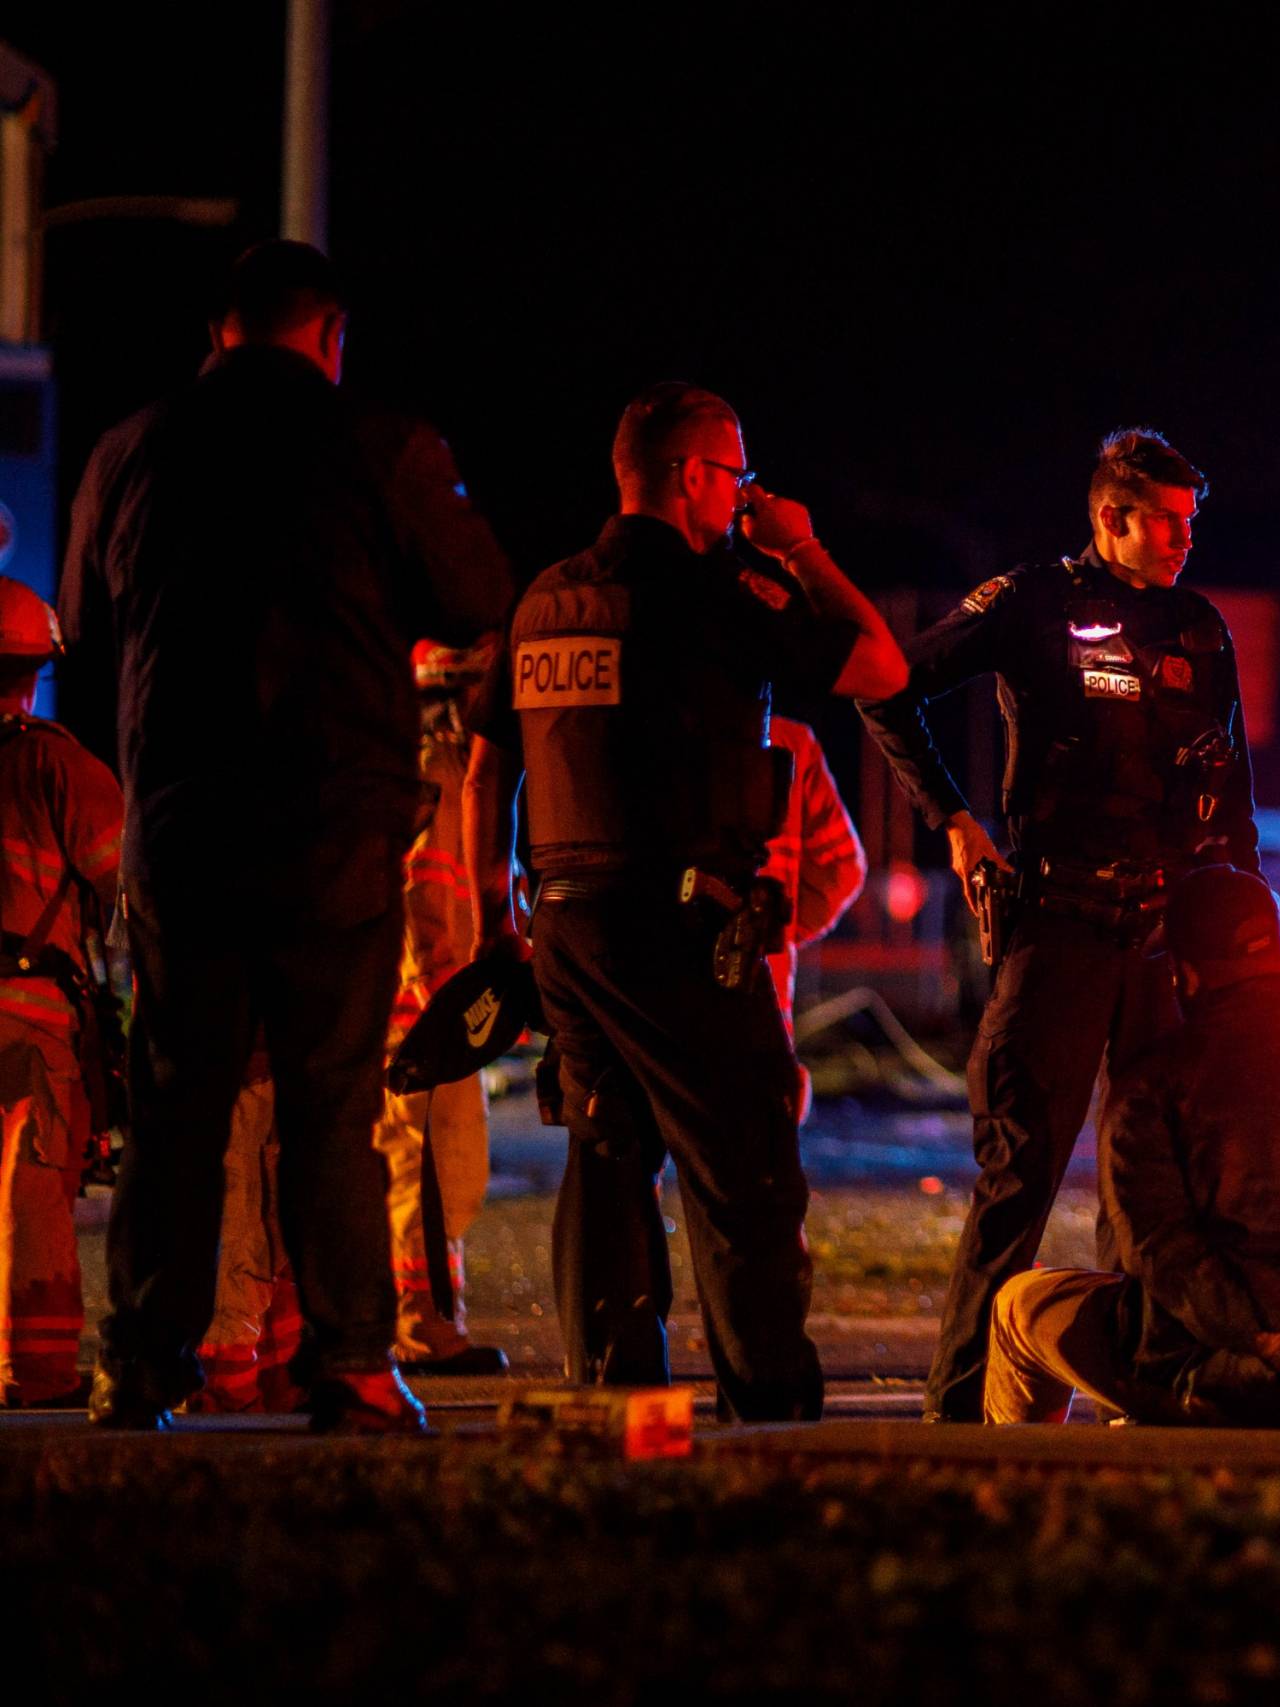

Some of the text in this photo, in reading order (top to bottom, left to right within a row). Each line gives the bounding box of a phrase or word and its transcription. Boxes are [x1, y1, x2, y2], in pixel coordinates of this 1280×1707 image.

[519, 650, 612, 693] POLICE
[1088, 675, 1136, 695] POLICE
[463, 987, 496, 1031] NIKE
